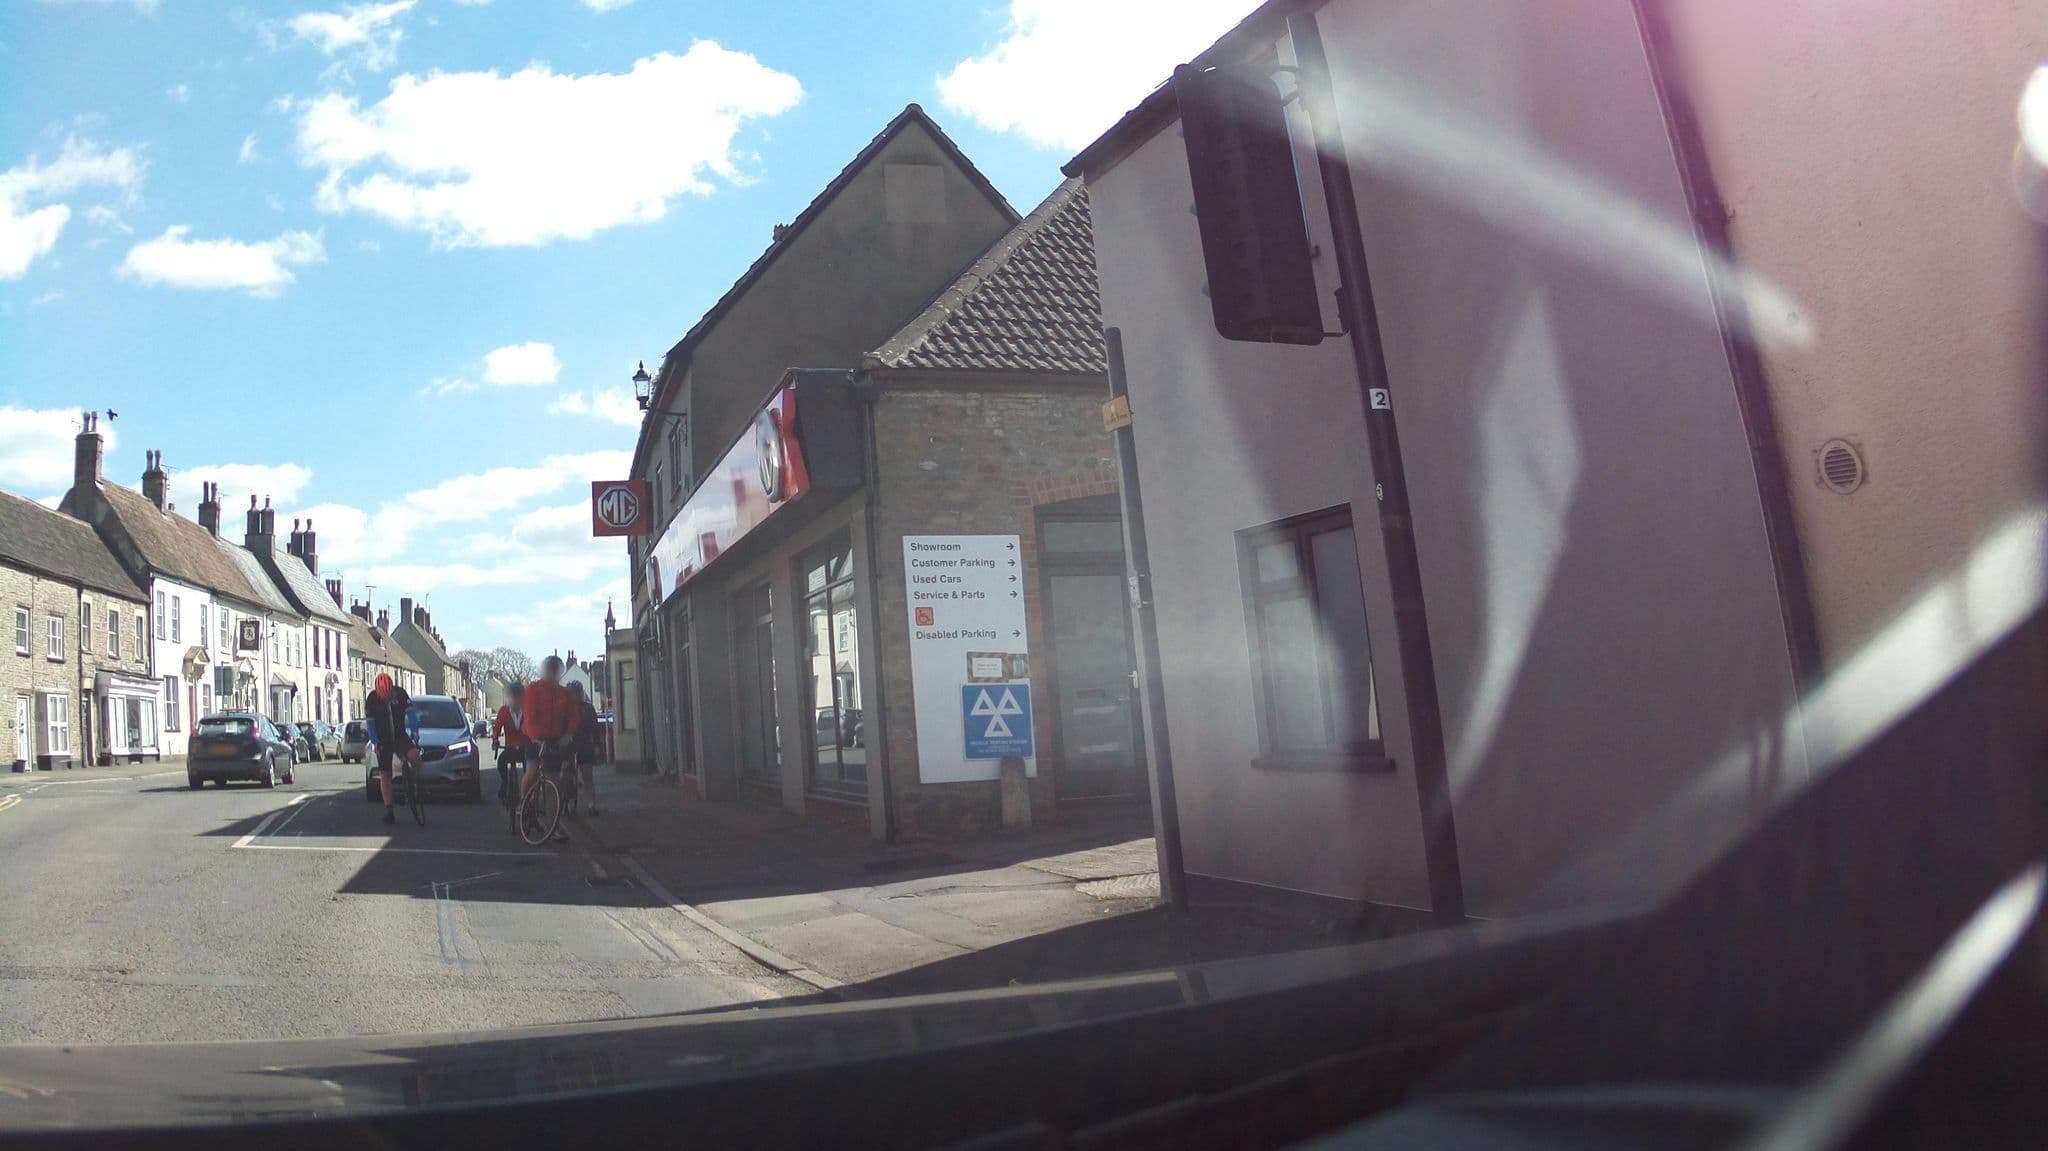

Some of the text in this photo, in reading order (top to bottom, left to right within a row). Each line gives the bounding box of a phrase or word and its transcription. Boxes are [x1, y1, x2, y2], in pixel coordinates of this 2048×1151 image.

[1375, 391, 1386, 406] 2
[602, 488, 636, 524] MG
[910, 542, 961, 551] Showroom
[911, 558, 996, 568] Customer Parking
[912, 574, 962, 583] Used Cars
[914, 590, 985, 599] Service & Parts
[916, 629, 996, 639] Disabled Parking
